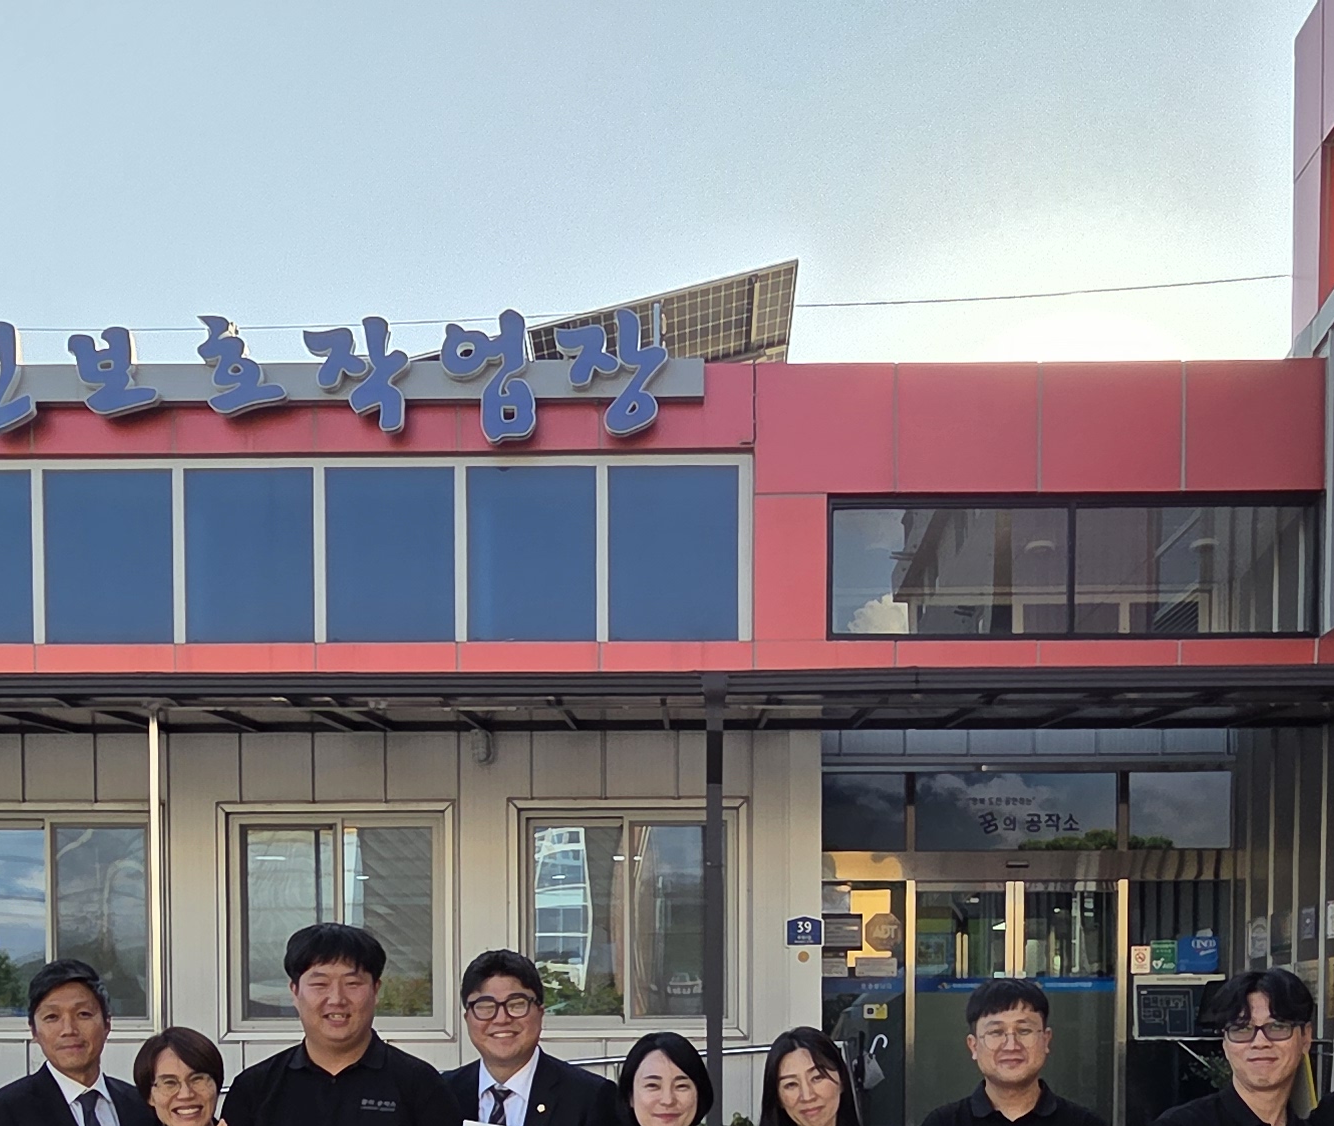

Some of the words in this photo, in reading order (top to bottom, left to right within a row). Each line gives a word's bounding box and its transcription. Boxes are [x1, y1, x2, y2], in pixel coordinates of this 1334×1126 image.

[978, 811, 1017, 834] 꿈의
[1025, 813, 1080, 832] 공작소
[796, 921, 813, 934] 39
